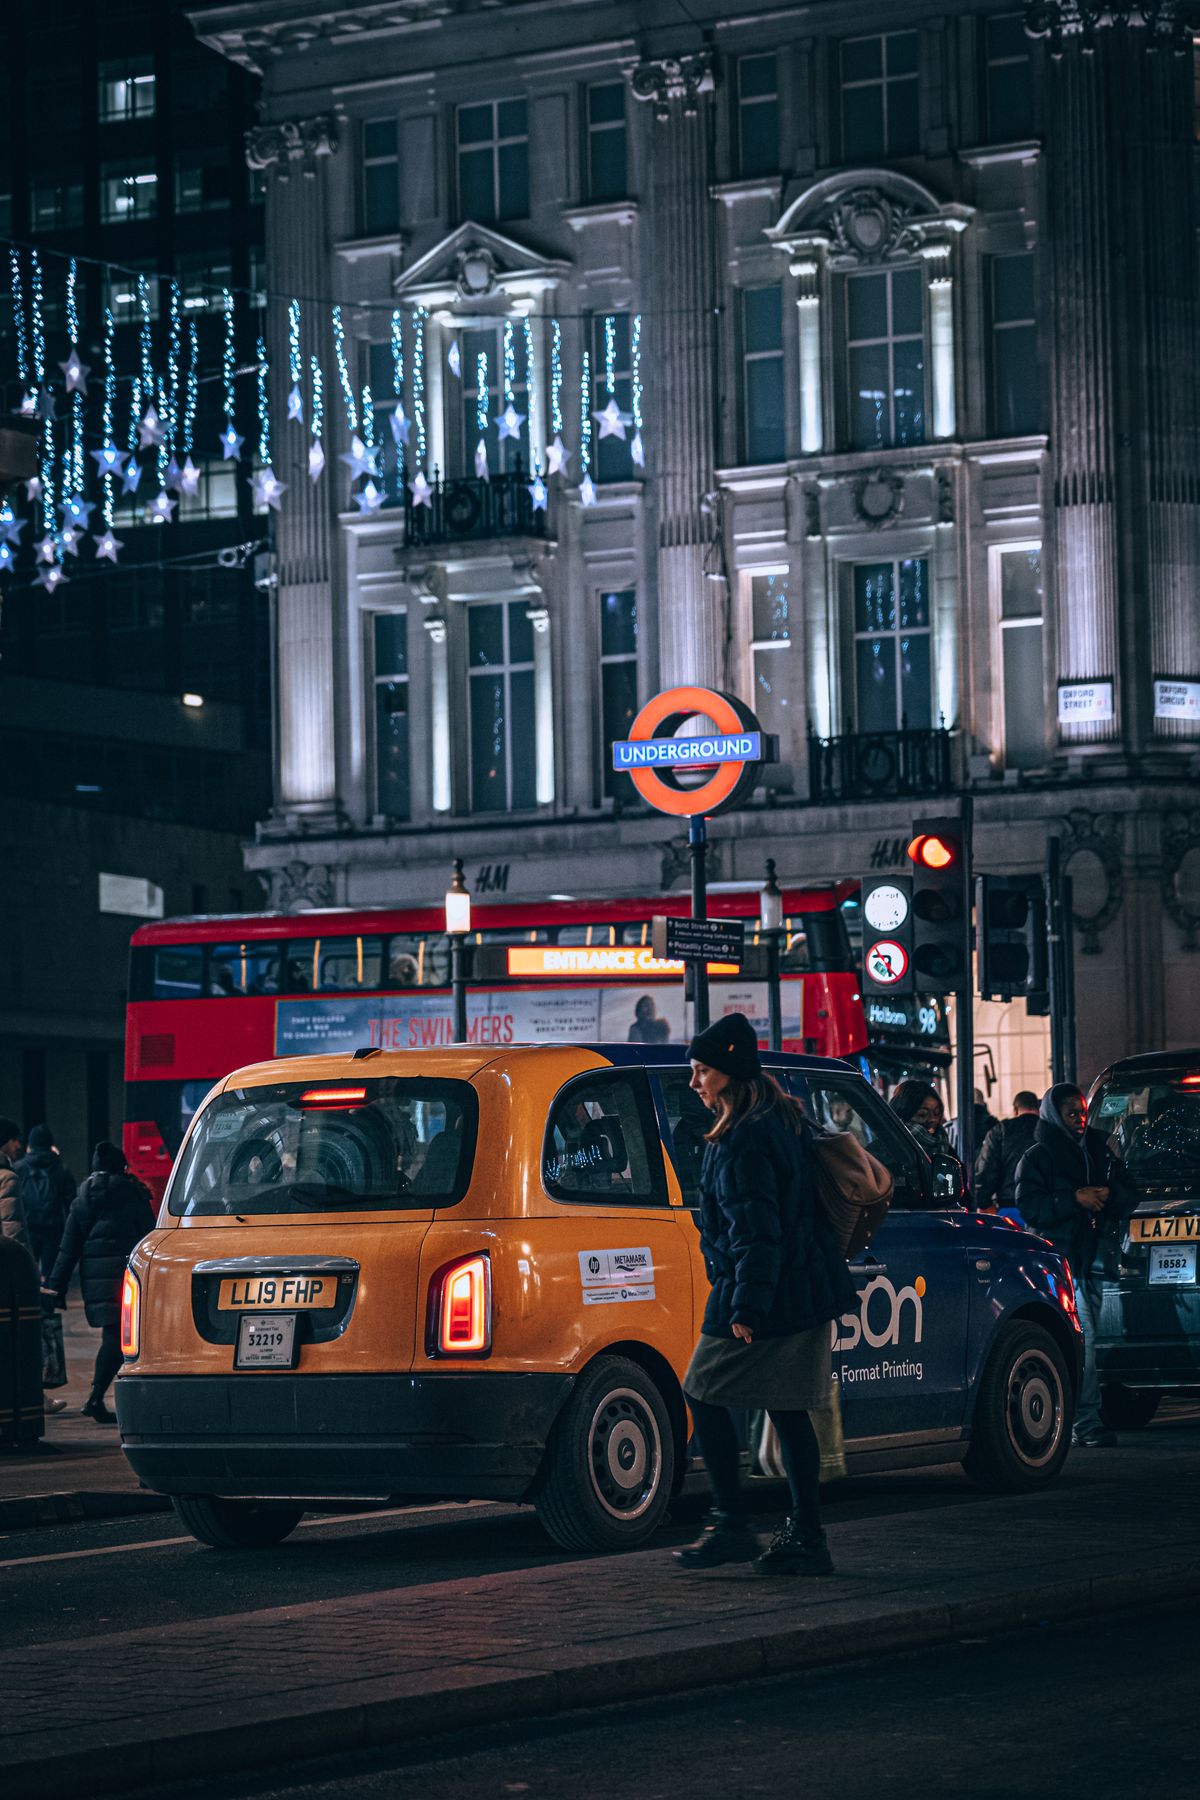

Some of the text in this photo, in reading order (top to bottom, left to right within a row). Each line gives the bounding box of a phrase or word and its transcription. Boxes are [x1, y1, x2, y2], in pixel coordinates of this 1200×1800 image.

[1063, 689, 1094, 699] OXFORD
[1063, 701, 1092, 710] STREET
[620, 739, 753, 763] UNDERGROUND
[674, 921, 710, 931] Bond Street
[674, 940, 722, 952] Piccadilly Circus
[543, 951, 635, 970] ENTRANCE
[869, 1004, 937, 1035] Holborn 98
[368, 1017, 402, 1047] THE
[1140, 1219, 1180, 1238] LA71
[614, 1254, 647, 1264] METAMARK
[1158, 1258, 1187, 1269] 18582
[230, 1280, 323, 1305] LL19 FHP
[248, 1333, 283, 1346] 32219
[841, 1364, 880, 1382] Format
[882, 1359, 923, 1380] Printing
